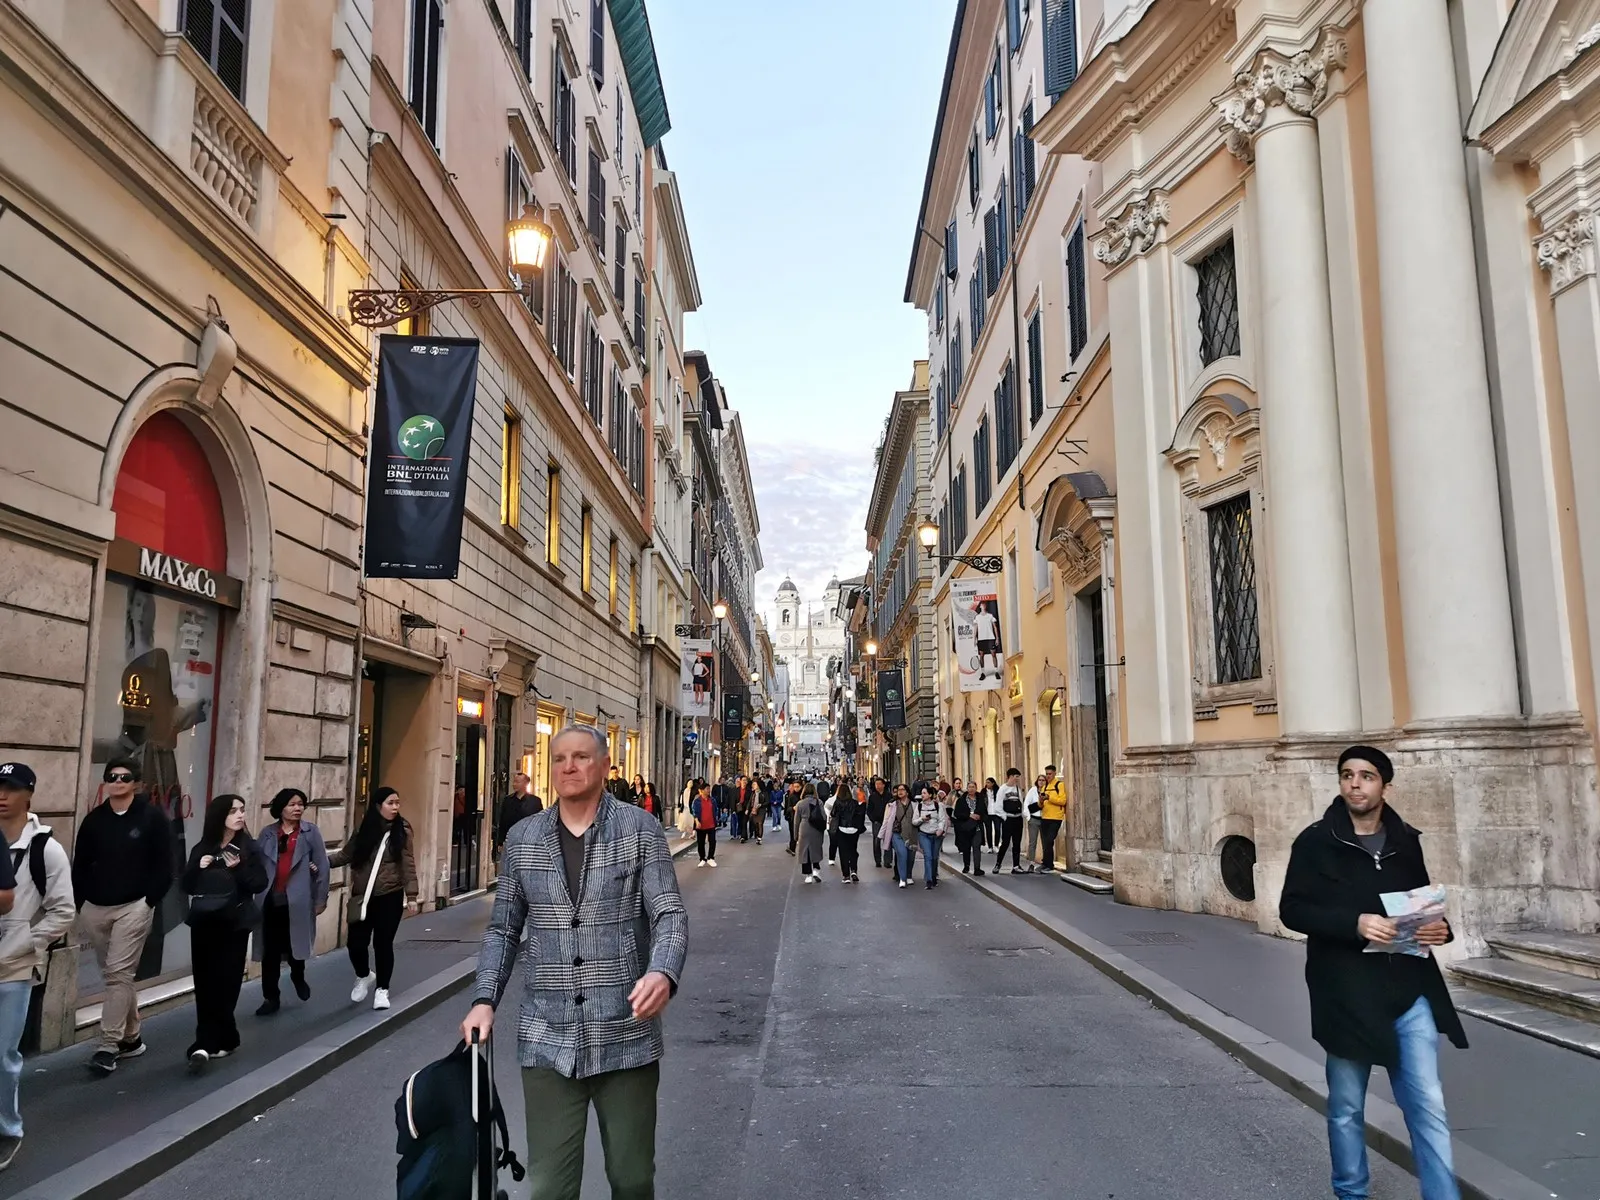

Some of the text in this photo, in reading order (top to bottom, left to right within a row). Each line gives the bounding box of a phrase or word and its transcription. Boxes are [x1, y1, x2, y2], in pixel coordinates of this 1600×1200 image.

[387, 464, 450, 473] INTERNAZIONALI
[387, 470, 412, 479] BNL
[414, 472, 449, 481] D'ITALIA
